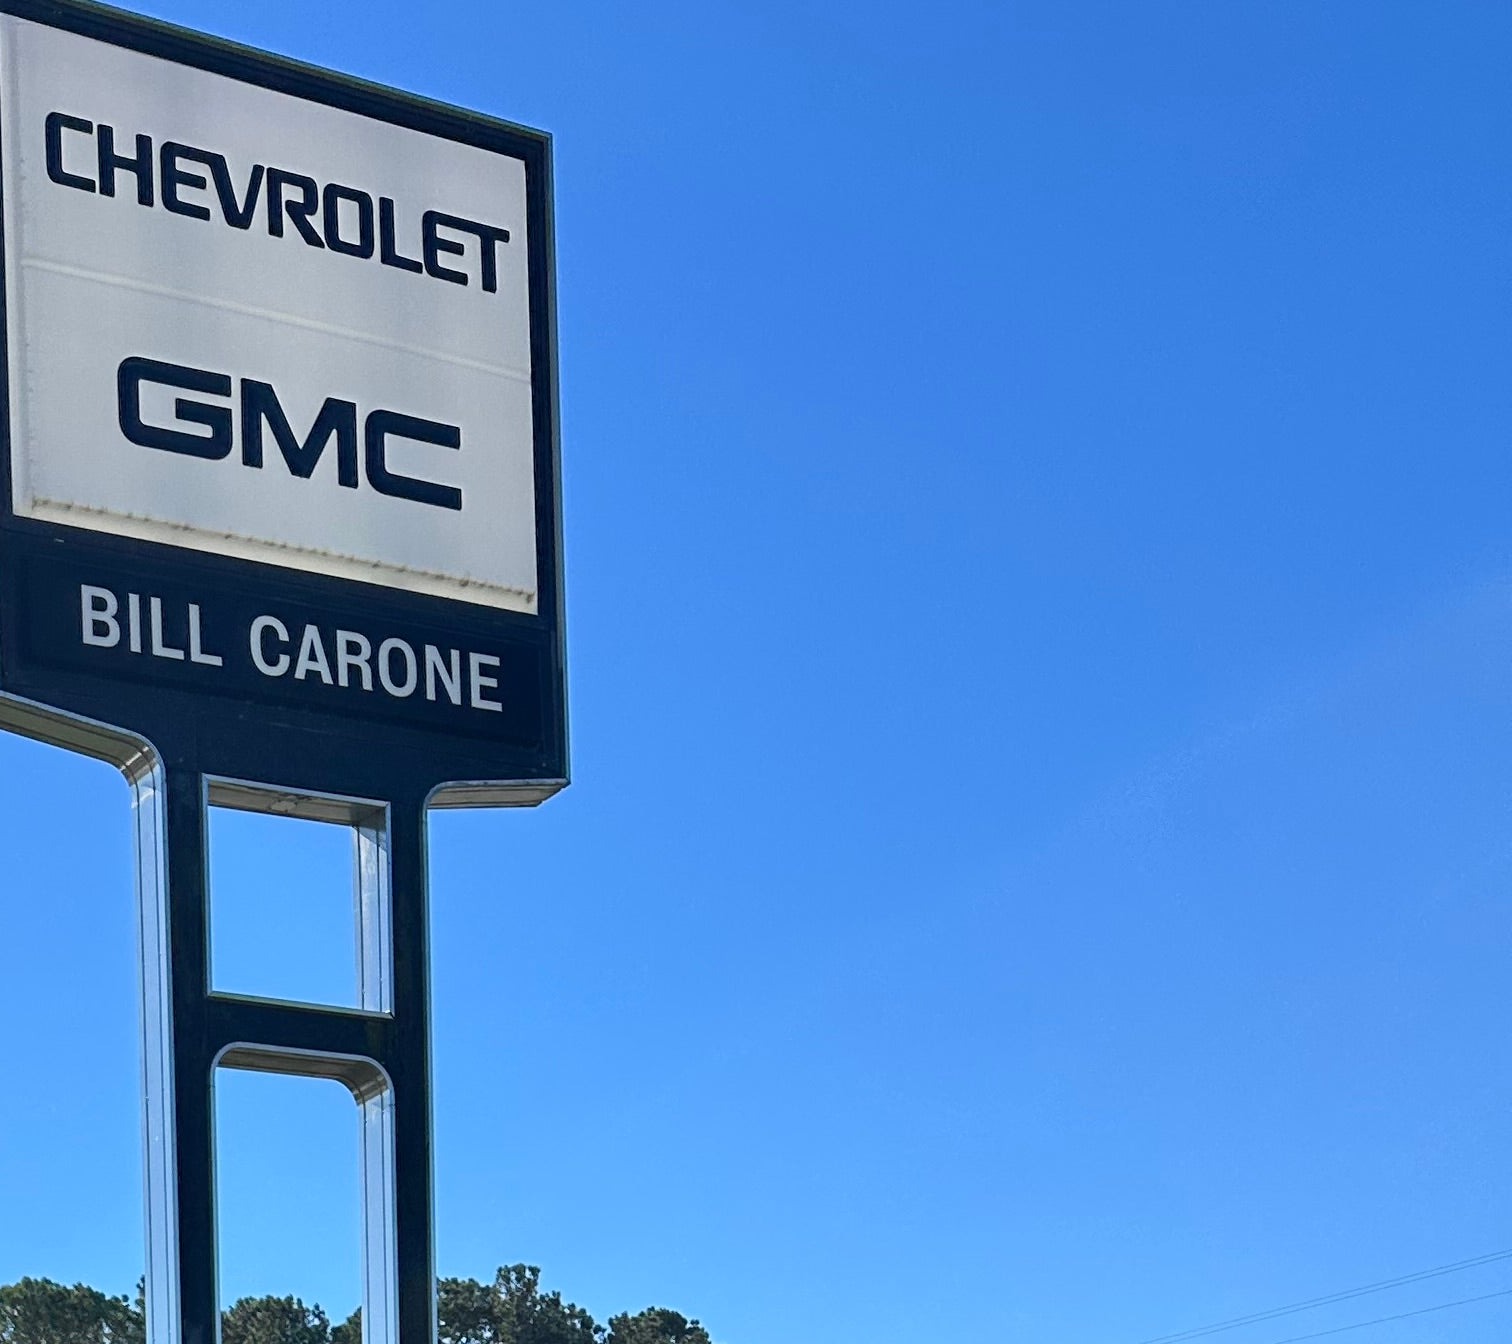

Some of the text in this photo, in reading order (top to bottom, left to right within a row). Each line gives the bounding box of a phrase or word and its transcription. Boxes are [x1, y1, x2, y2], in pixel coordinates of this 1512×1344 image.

[45, 111, 510, 294] CHEVROLET
[117, 356, 463, 511] GMC
[80, 584, 504, 712] BILL CARONE
